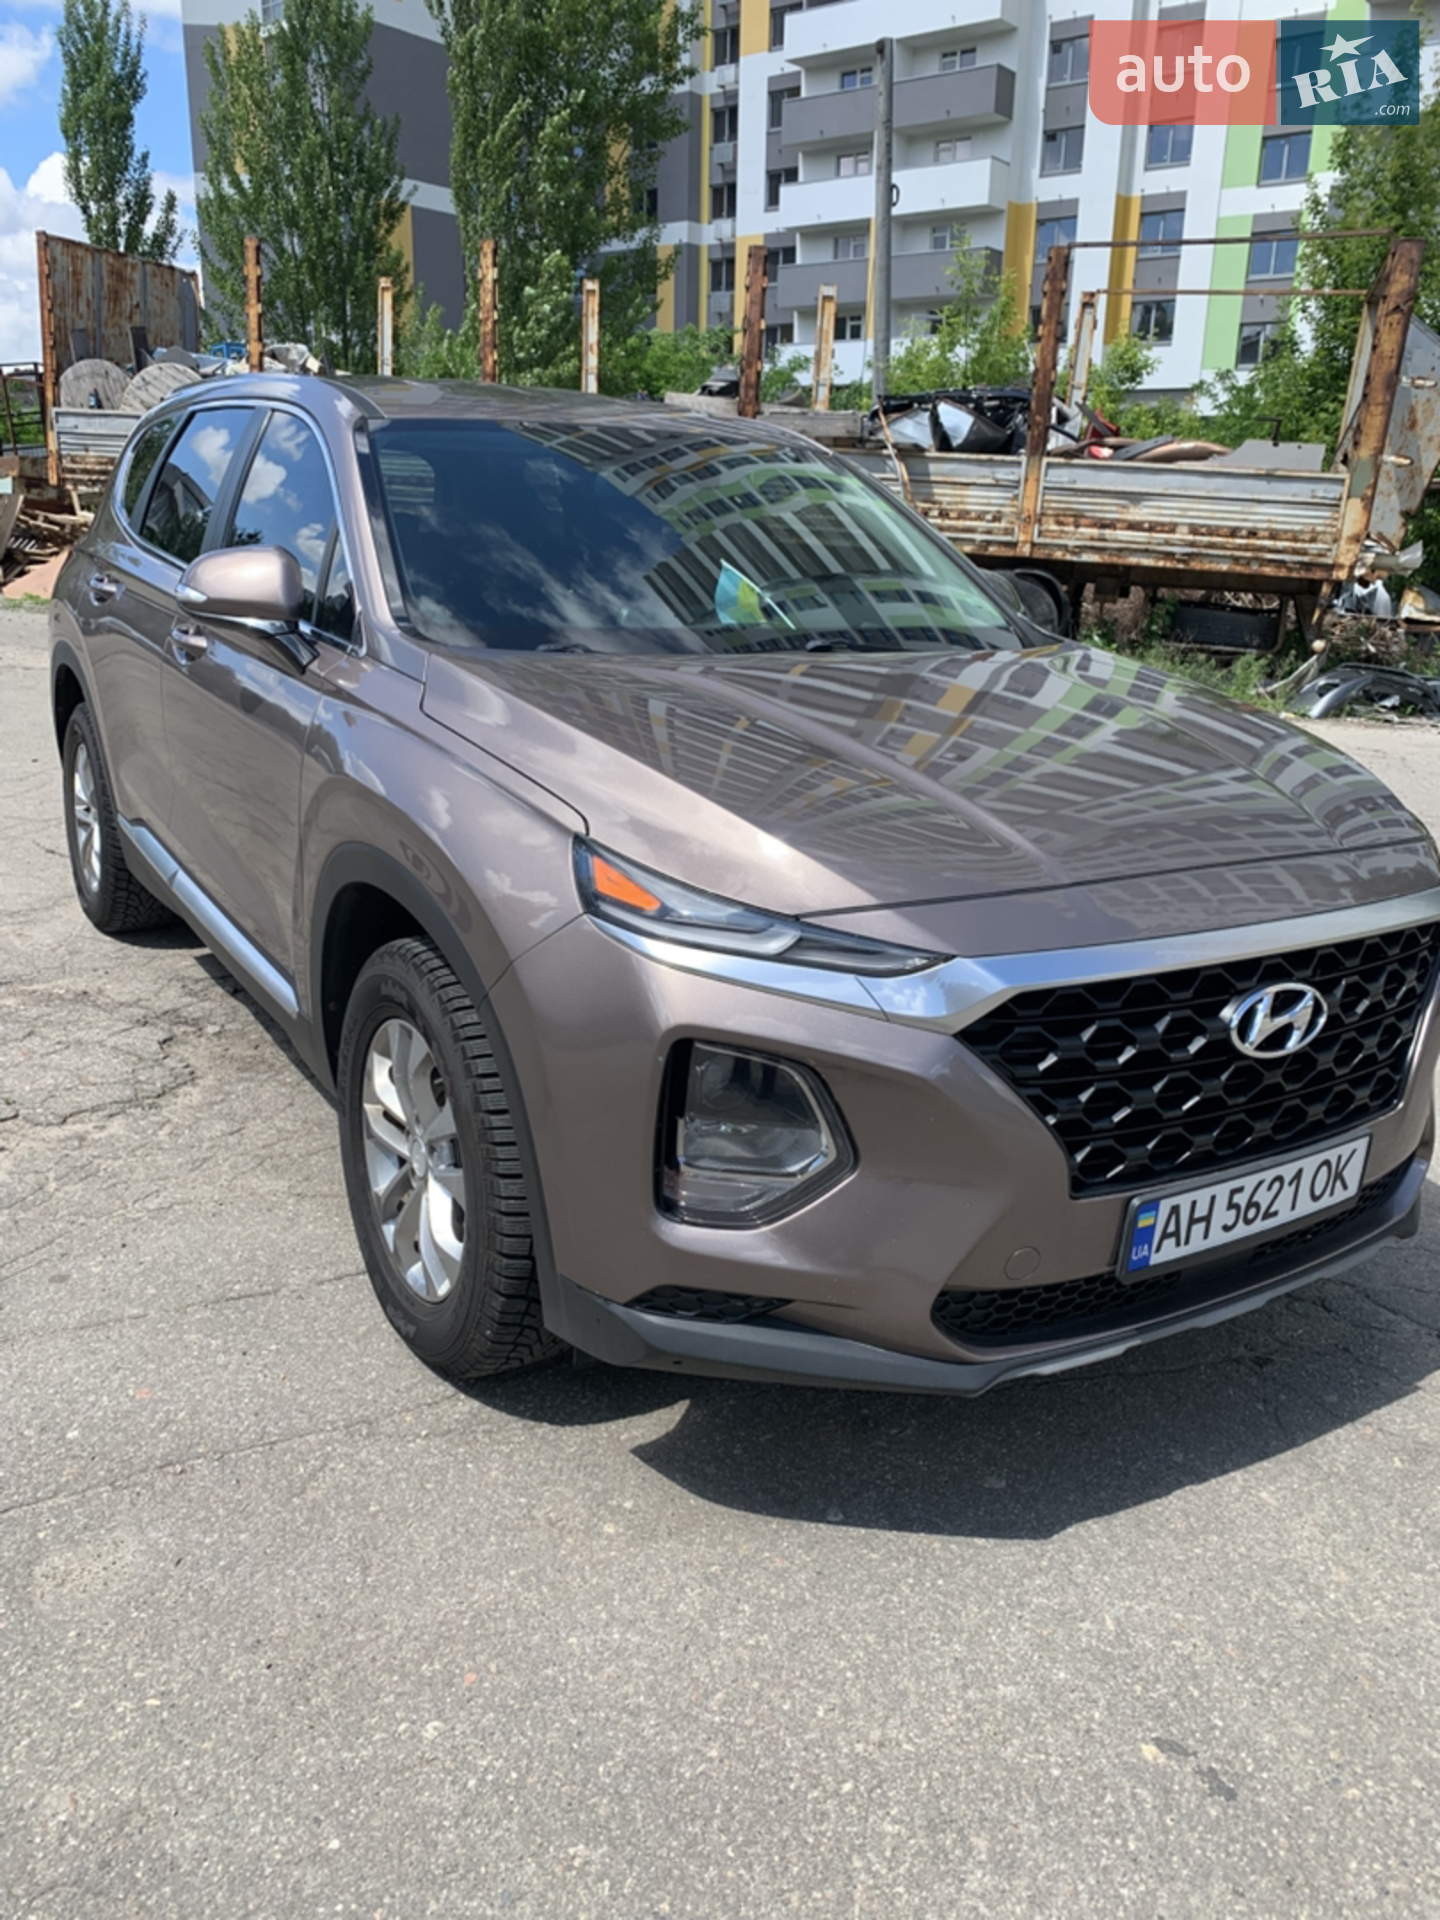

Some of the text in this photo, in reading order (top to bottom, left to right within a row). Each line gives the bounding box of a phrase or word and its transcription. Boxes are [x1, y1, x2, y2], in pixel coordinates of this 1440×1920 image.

[1154, 1148, 1358, 1254] AH 5621 OK
[1131, 1244, 1150, 1261] UA
